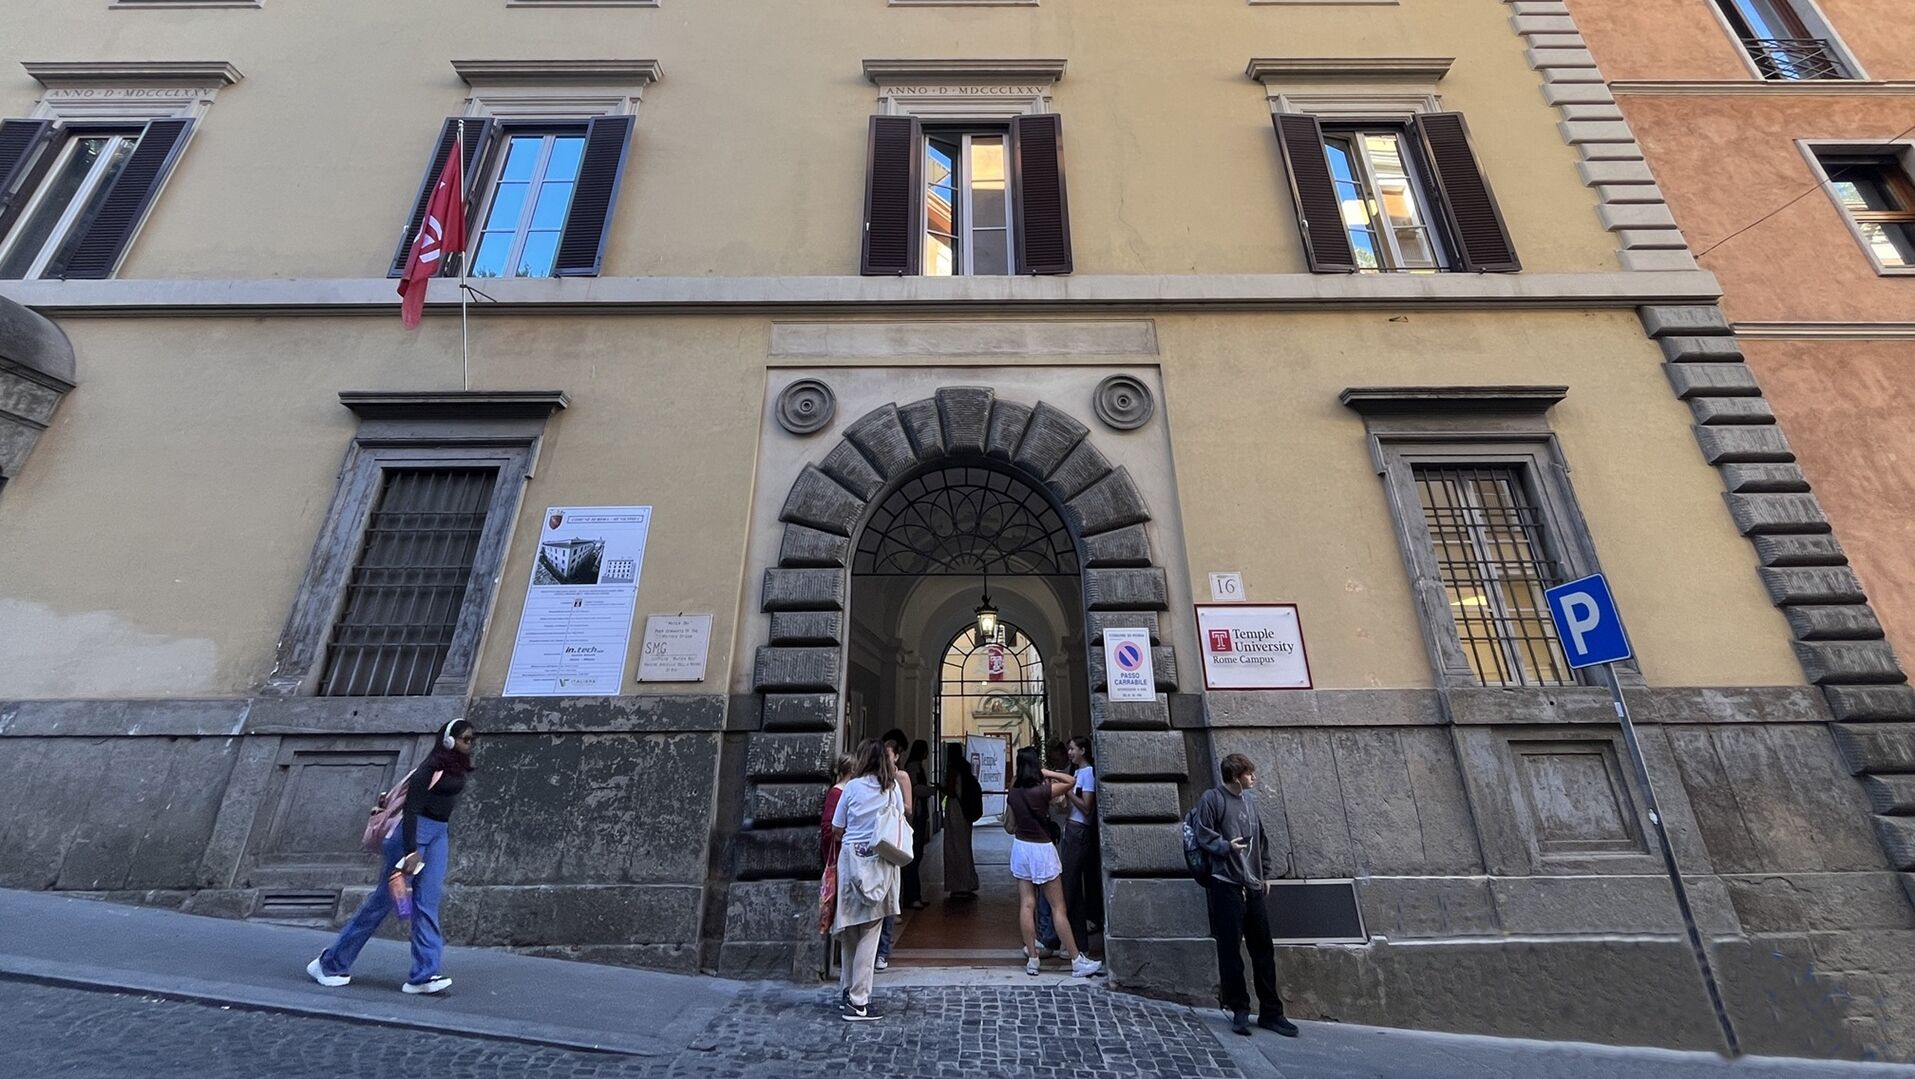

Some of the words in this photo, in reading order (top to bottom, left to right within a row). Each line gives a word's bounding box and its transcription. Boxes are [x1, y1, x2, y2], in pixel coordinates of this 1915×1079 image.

[51, 88, 95, 97] ANNO
[104, 88, 115, 97] D
[886, 86, 928, 95] ANNO
[939, 86, 948, 95] D
[1217, 579, 1235, 593] 16
[1559, 591, 1600, 655] P
[1232, 628, 1275, 641] Temple
[645, 641, 667, 654] SMG
[1235, 641, 1294, 654] University
[1212, 655, 1238, 664] Rome
[1239, 655, 1275, 666] Campus
